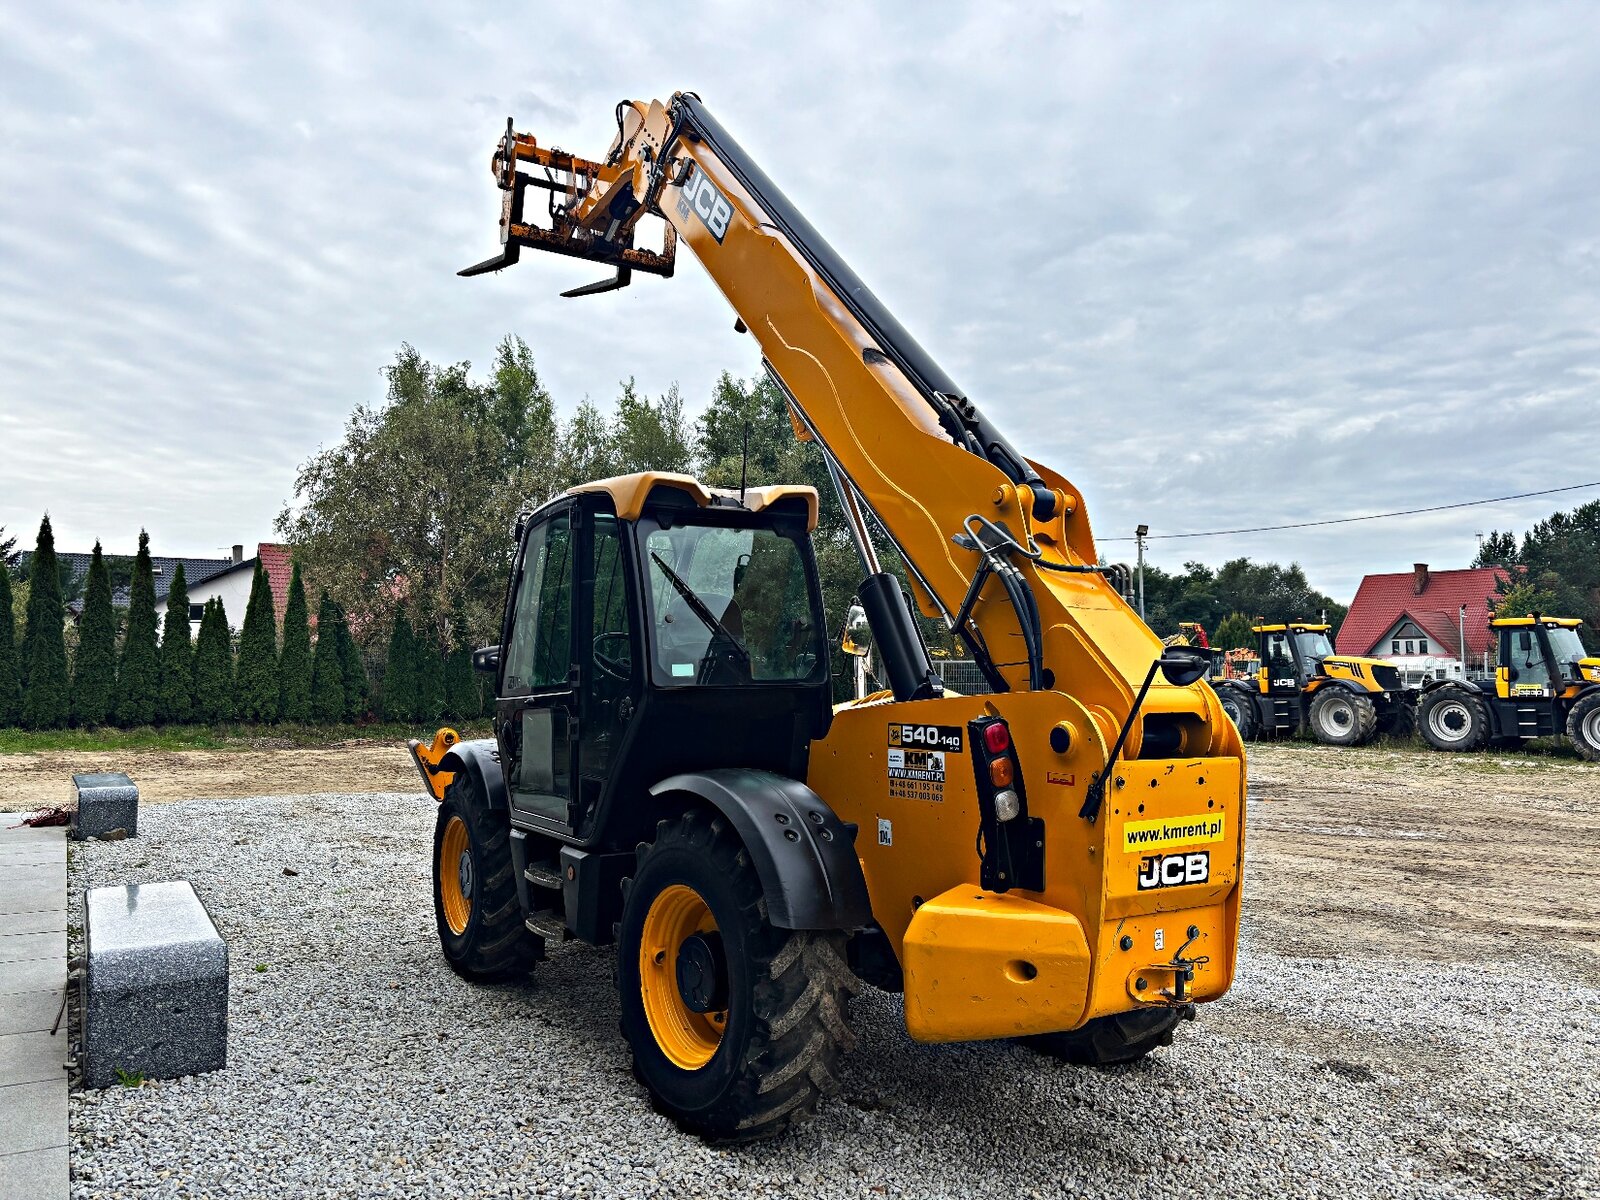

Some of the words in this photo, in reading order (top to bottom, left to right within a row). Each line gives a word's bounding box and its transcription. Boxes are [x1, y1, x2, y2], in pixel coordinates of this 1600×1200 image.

[683, 171, 731, 239] JCB
[1273, 678, 1295, 688] JCB
[904, 751, 927, 766] KM
[888, 768, 945, 782] WWW.KMRENT.PL
[1127, 819, 1222, 844] www.kmrent.pl
[1139, 854, 1209, 888] JCB
